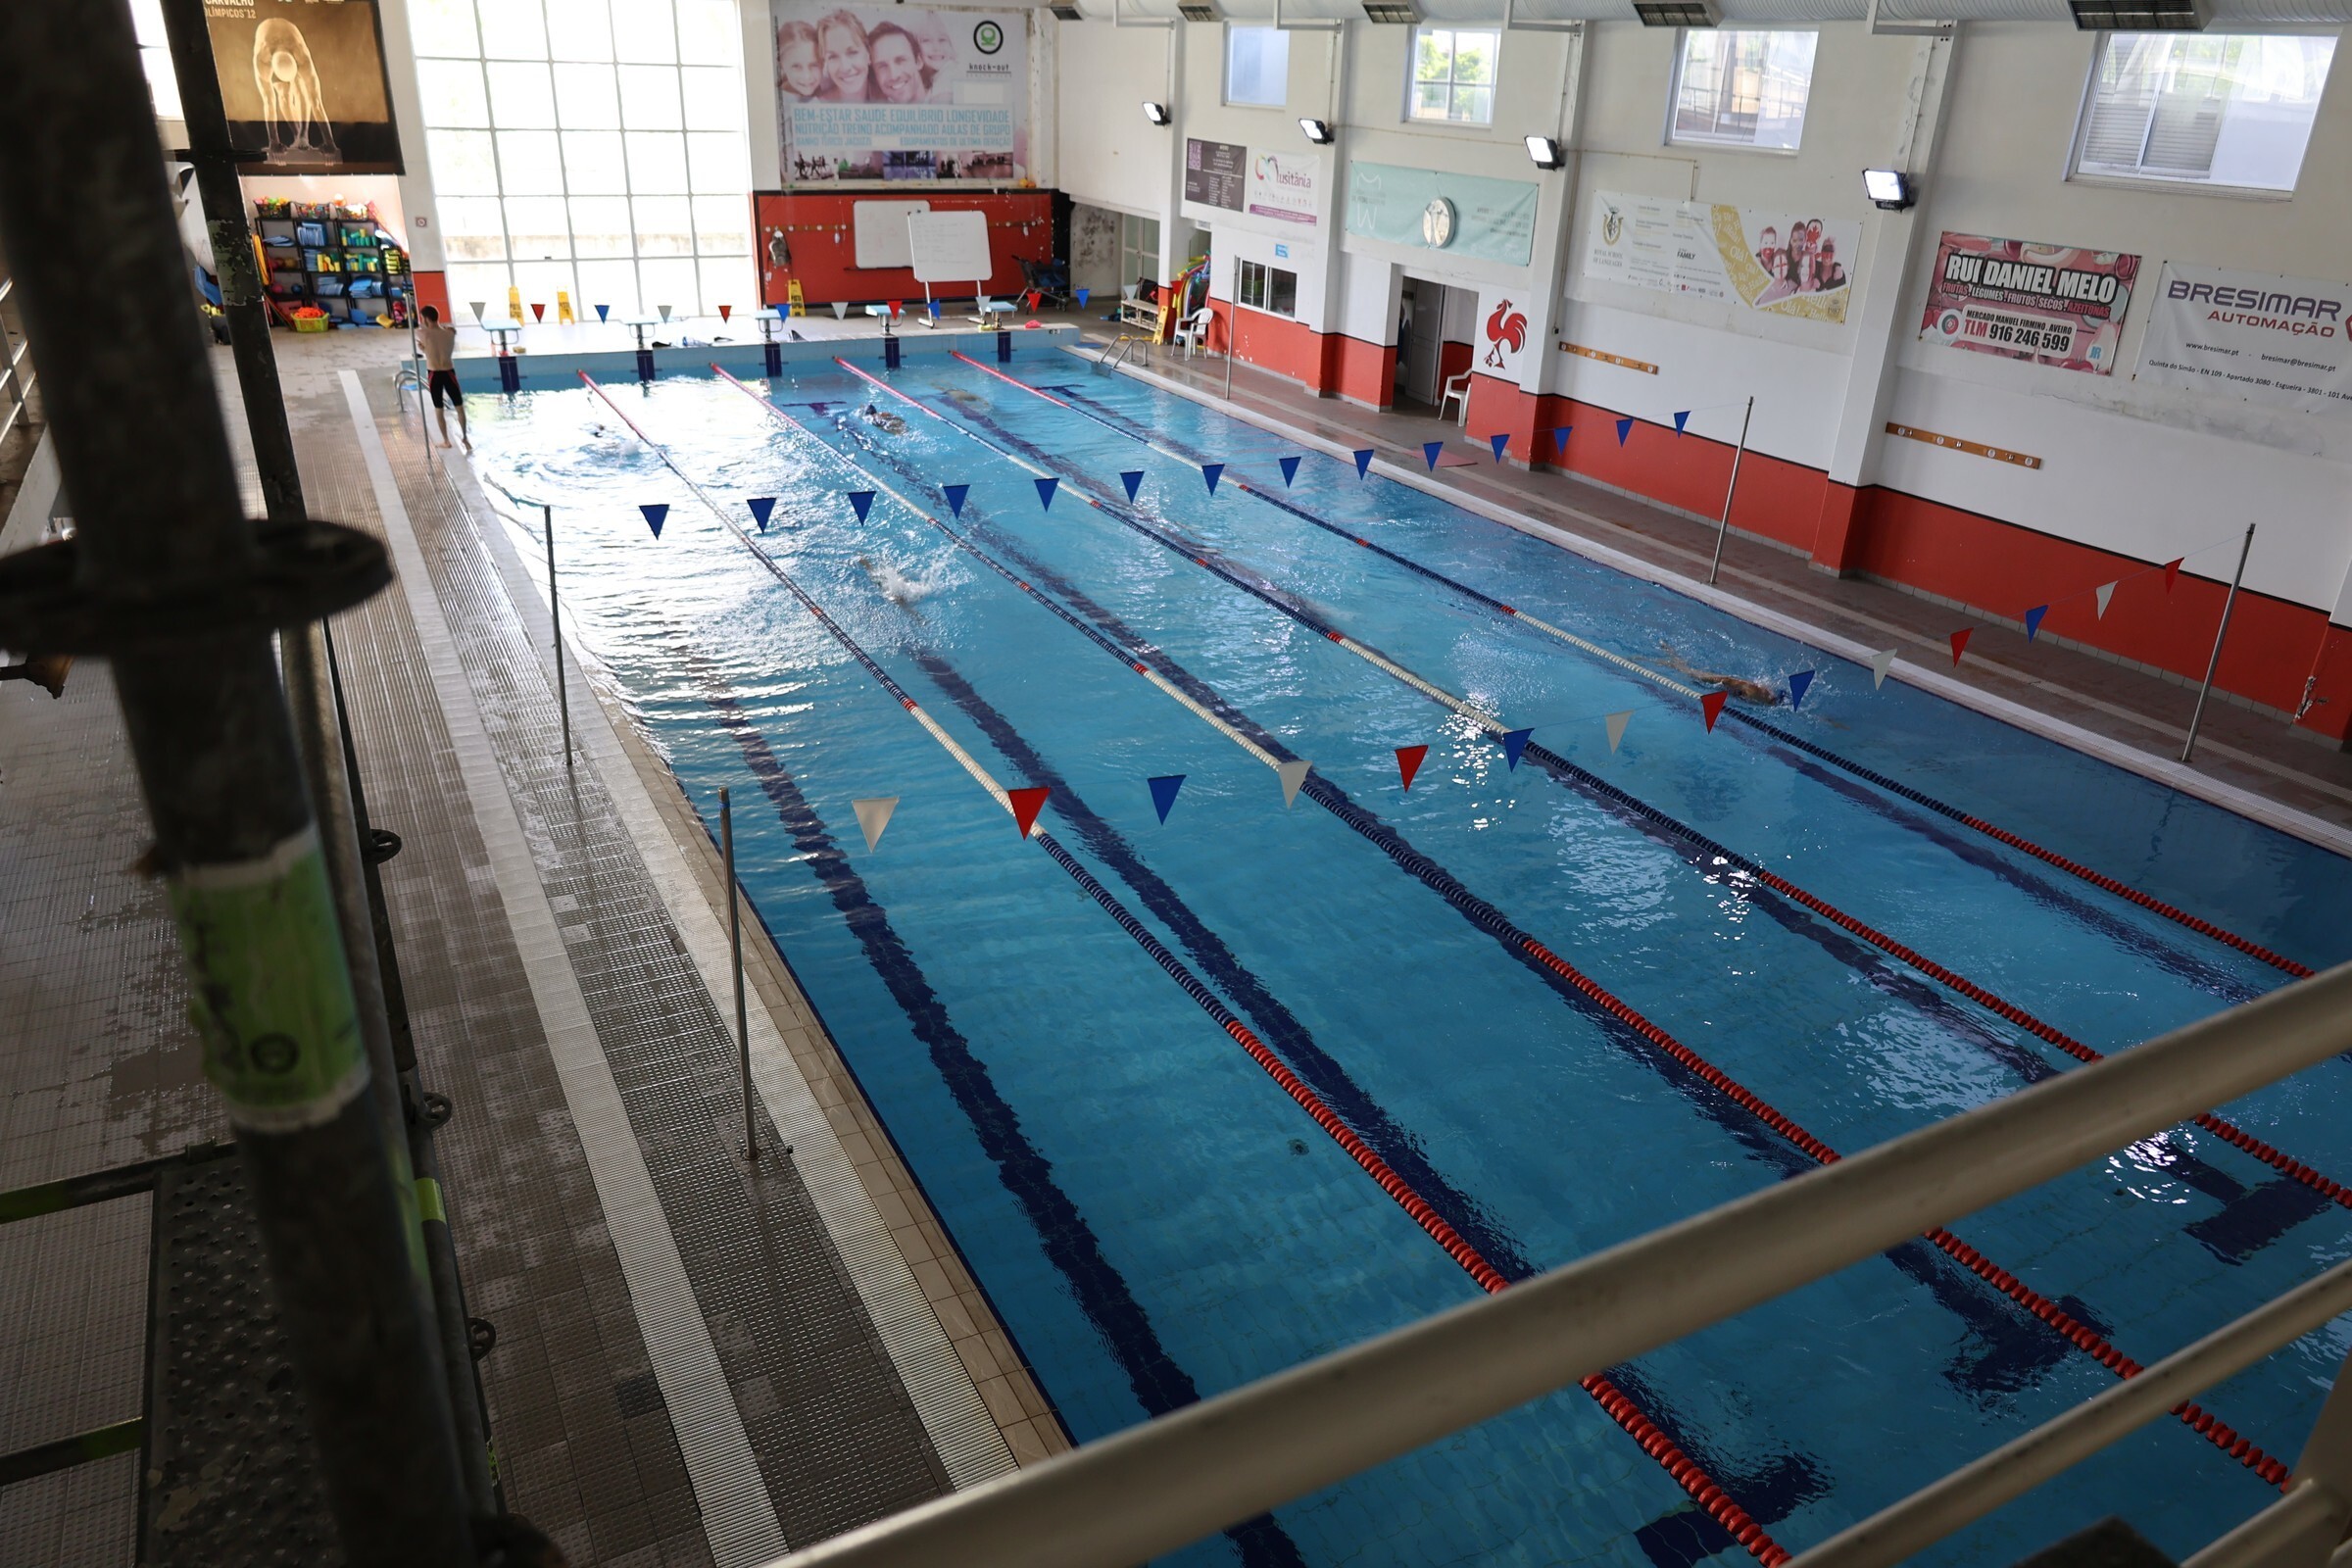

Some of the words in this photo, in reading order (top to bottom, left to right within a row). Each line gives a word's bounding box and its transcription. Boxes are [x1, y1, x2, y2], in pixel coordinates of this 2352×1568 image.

[794, 108, 852, 122] BEM-ESTAR
[891, 107, 944, 122] EQUILÍBRIO
[947, 110, 1009, 122] LONGEVIDADE
[843, 123, 872, 134] TREINO
[875, 123, 939, 134] ACOMPANHADO
[942, 124, 968, 135] AULAS
[970, 124, 981, 135] DE
[983, 124, 1010, 135] GRUPO
[1677, 251, 1695, 260] FAMILY
[1945, 255, 1983, 283] RUI
[1984, 260, 2054, 294] DANIEL
[2056, 270, 2117, 303] MELO
[2007, 293, 2036, 307] FRUTOS
[2067, 301, 2110, 318] AZEITONAS
[2167, 279, 2342, 321] BRESIMAR
[1964, 318, 1988, 337] TLM
[1988, 323, 2013, 342] 916
[2014, 327, 2040, 347] 246
[2041, 333, 2070, 352] 599
[1966, 310, 1995, 322] MERCADO
[1995, 315, 2019, 326] MANUEL
[2020, 318, 2046, 330] FIRMINO
[2049, 323, 2073, 335] AVEIRO
[2207, 310, 2335, 338] AUTOMAÇÃO
[2185, 342, 2239, 357] www.bresimar.pt
[2261, 353, 2336, 372] bresimar@bresimar.pt
[2148, 359, 2169, 368] Quinta
[2179, 364, 2195, 373] Simão
[2227, 372, 2254, 383] Apartado
[2255, 377, 2271, 386] 3080
[2275, 381, 2302, 392] Esgueira
[2307, 386, 2323, 396] 3801
